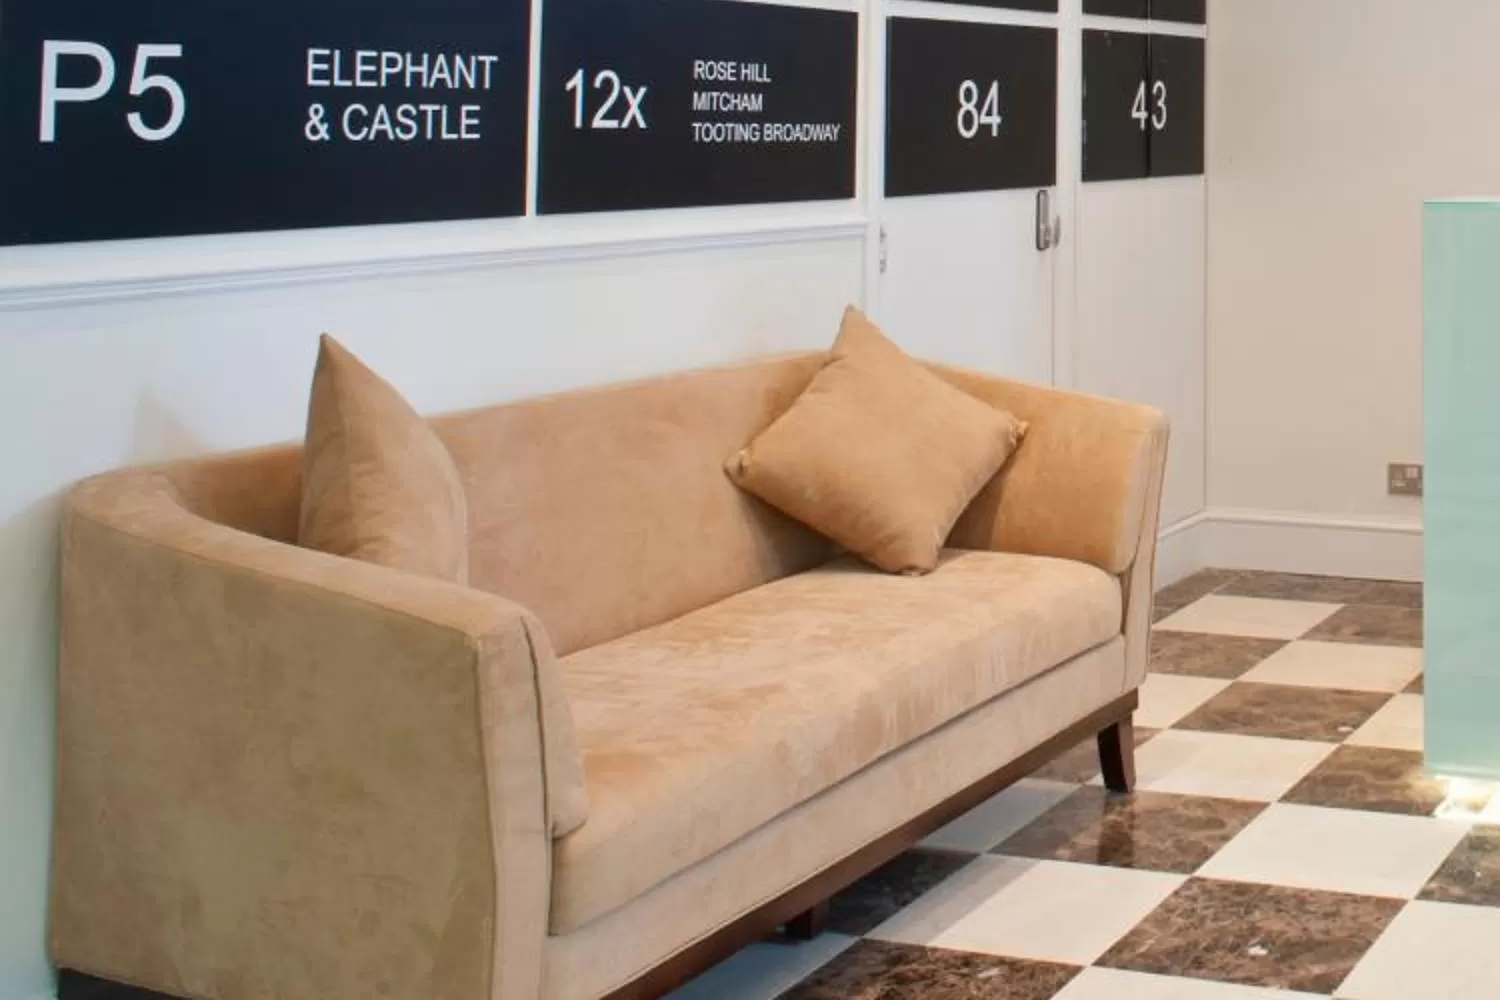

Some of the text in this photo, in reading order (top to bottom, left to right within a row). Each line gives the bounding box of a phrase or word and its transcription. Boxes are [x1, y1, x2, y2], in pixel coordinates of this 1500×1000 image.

[306, 49, 497, 89] ELEPHANT
[695, 60, 771, 83] ROSE HILL
[39, 40, 185, 143] P5
[565, 69, 647, 129] 12x
[693, 91, 763, 113] MITCHAM
[957, 80, 1001, 139] 84
[1131, 80, 1167, 130] 43
[305, 104, 480, 140] & CASTLE
[693, 123, 840, 142] TOOTING BROADWAY
